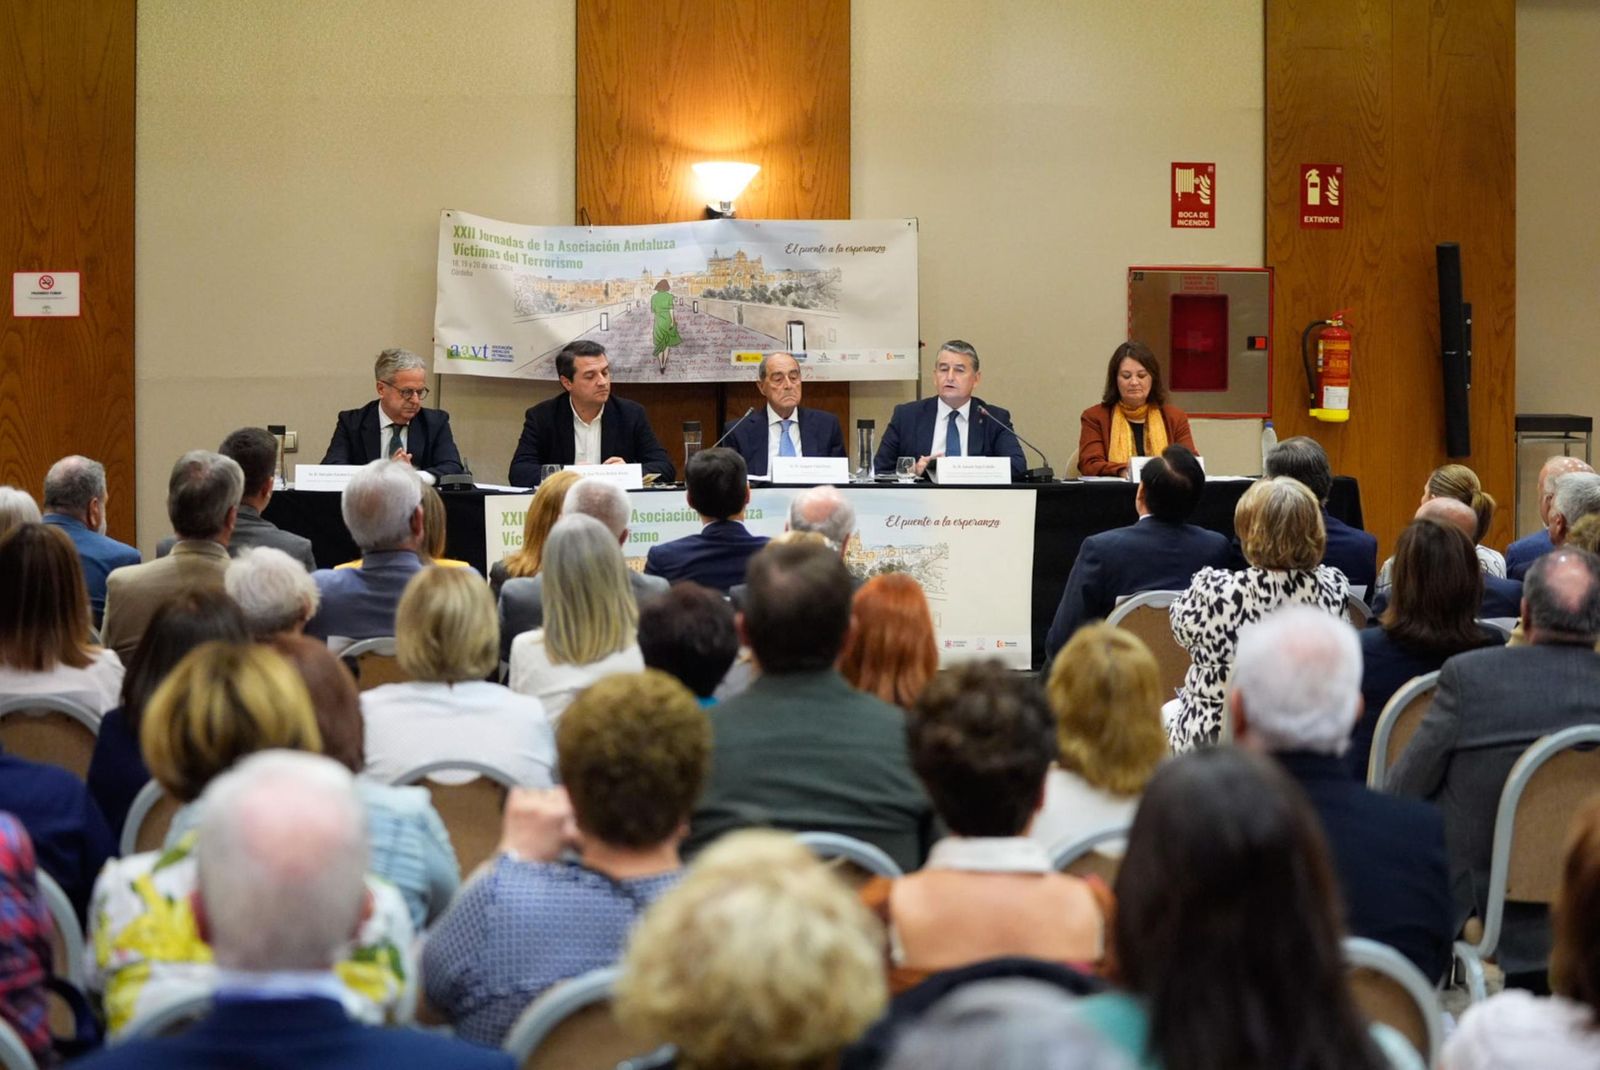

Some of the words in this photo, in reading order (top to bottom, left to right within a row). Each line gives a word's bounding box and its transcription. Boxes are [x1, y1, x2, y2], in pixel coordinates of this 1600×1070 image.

[1199, 211, 1209, 219] DE
[1303, 215, 1340, 224] EXTINTOR
[1177, 219, 1210, 227] INCENDIO
[453, 225, 476, 240] XXII
[479, 229, 525, 249] Jornadas
[527, 239, 541, 252] de
[544, 240, 554, 252] la
[558, 239, 620, 252] Asociación
[623, 238, 676, 252] Andaluza
[453, 242, 501, 260] Víctimas
[503, 251, 519, 264] del
[521, 253, 583, 270] Terrorismo
[785, 243, 799, 255] El
[798, 244, 827, 256] puente
[835, 243, 844, 254] la
[845, 245, 886, 256] esperanza
[449, 343, 489, 359] aavt
[631, 508, 701, 523] Asociación
[886, 515, 901, 527] El
[901, 516, 932, 529] puente
[941, 515, 951, 527] la
[953, 518, 1000, 529] esperanza
